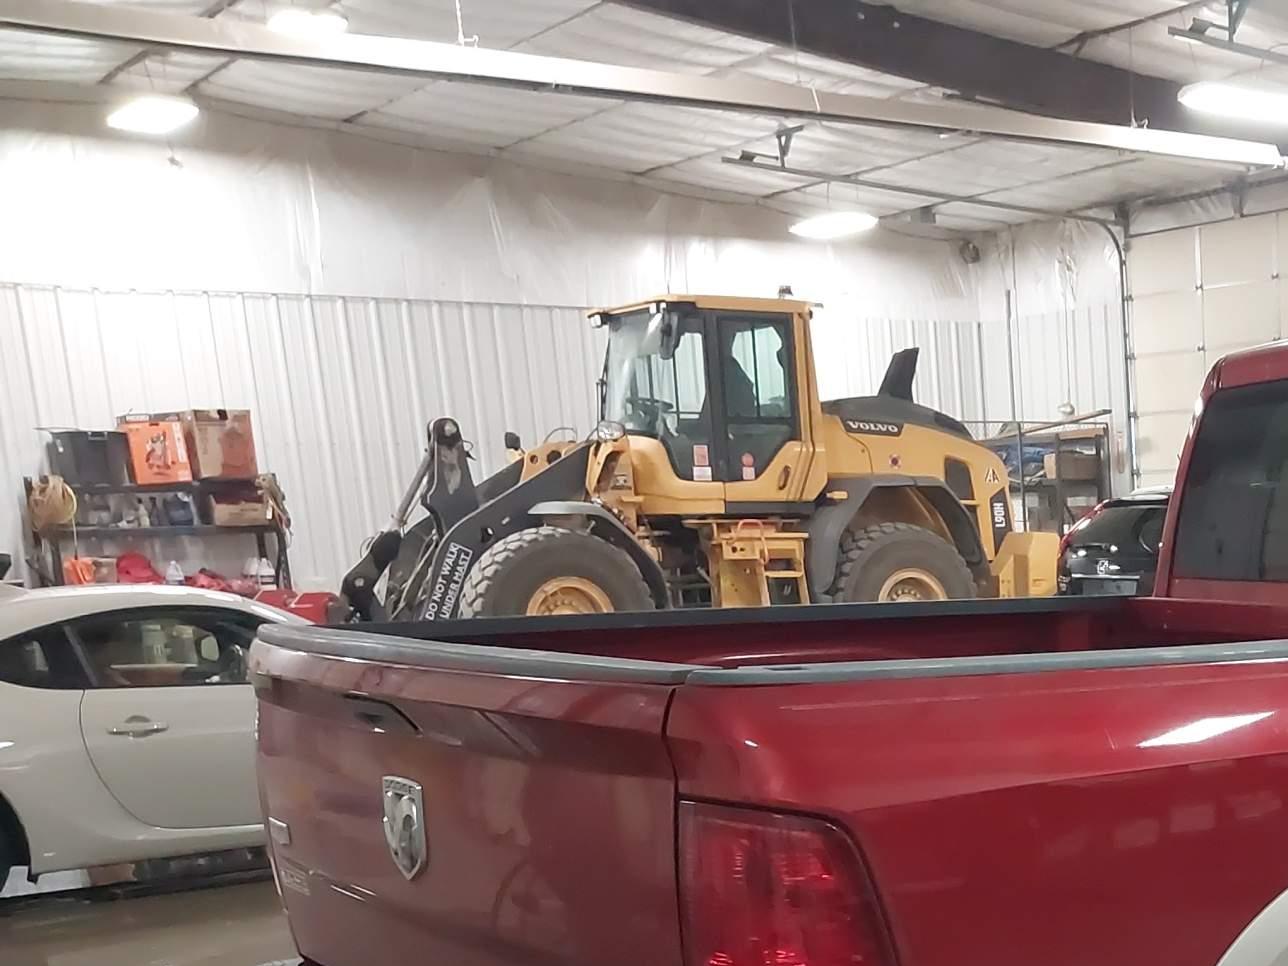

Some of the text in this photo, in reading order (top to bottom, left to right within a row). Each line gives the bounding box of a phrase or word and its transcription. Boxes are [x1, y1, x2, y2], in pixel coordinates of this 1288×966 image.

[846, 420, 899, 433] VOLVO
[992, 502, 1006, 528] L90H
[425, 542, 461, 621] DO NOT WALK
[440, 552, 470, 619] UNDER MAST
